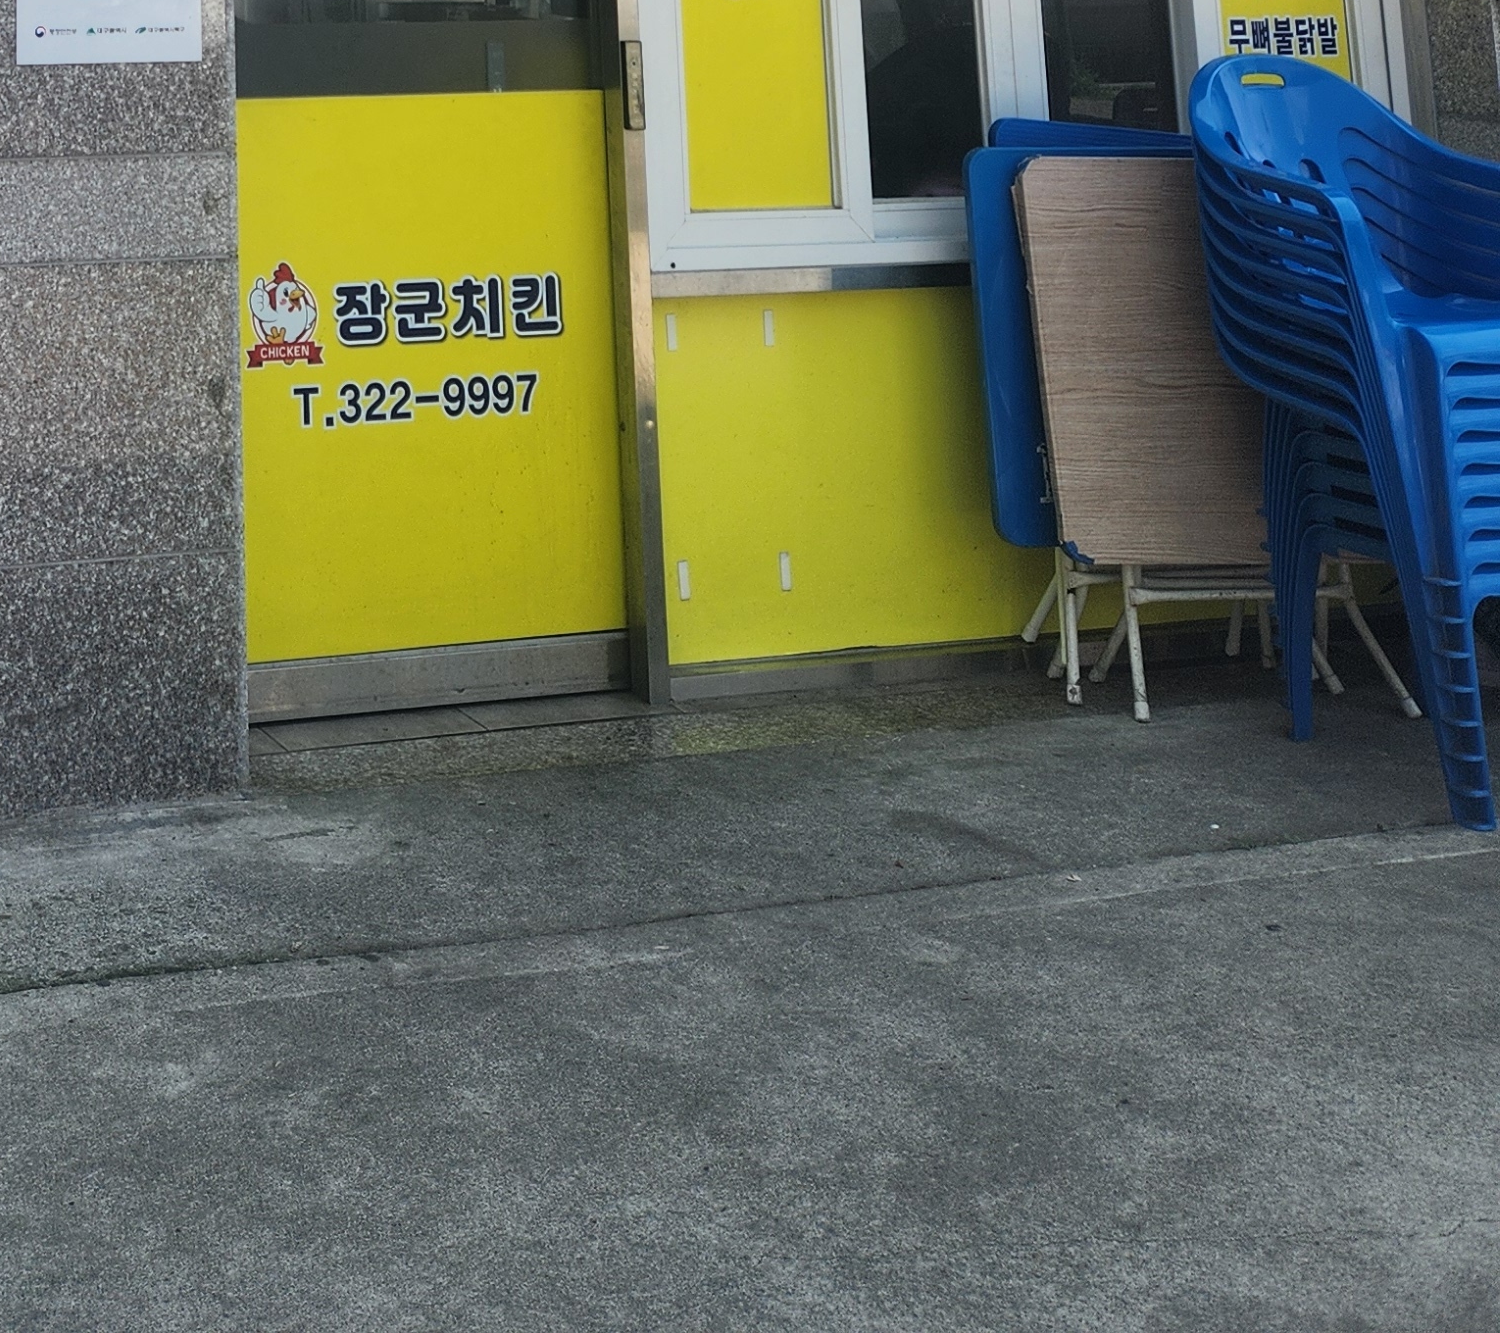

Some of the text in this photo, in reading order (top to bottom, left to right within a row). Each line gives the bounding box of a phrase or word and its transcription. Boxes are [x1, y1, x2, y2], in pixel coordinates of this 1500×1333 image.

[1228, 16, 1339, 56] 무뼈불닭발
[334, 273, 561, 344] 장군치킨
[260, 344, 311, 360] CHICKEN
[293, 373, 538, 428] T.322-9997
